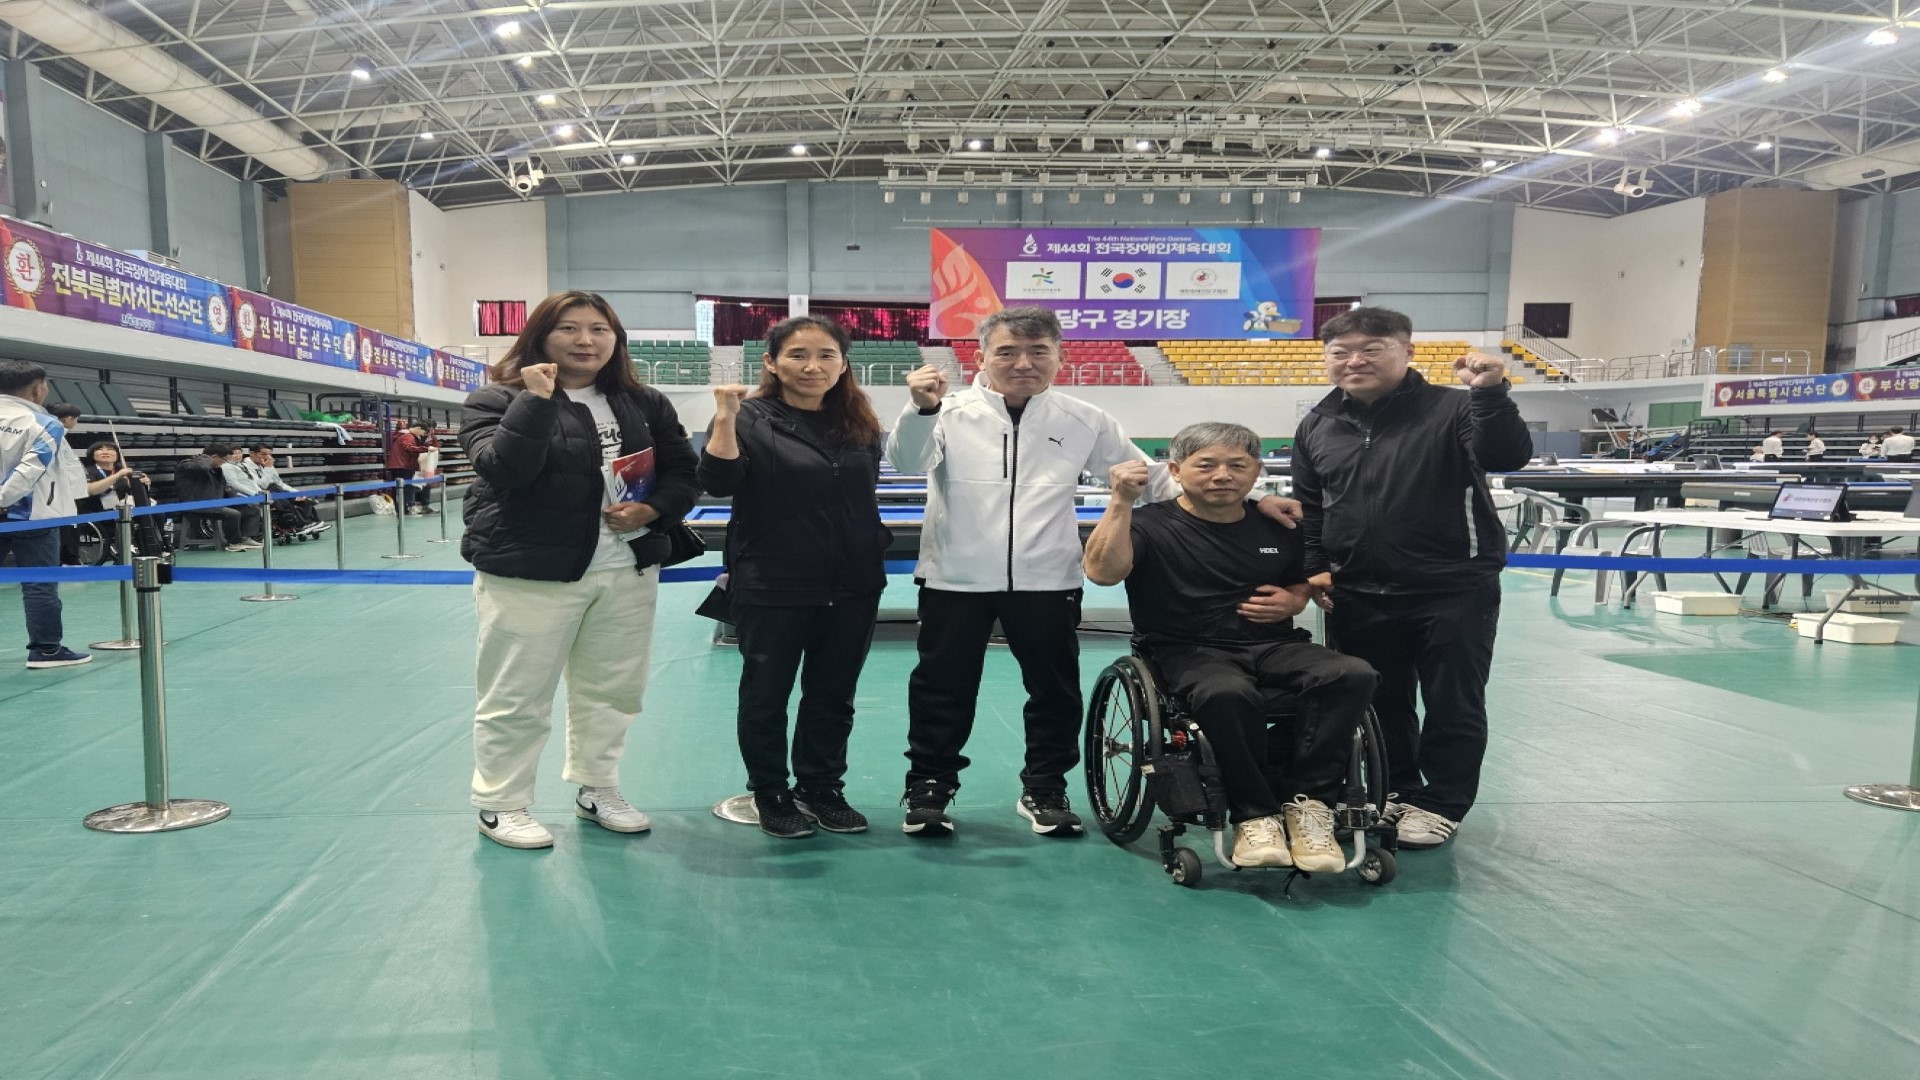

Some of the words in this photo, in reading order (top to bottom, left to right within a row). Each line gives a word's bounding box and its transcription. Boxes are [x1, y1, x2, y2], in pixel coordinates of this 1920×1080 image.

[1047, 243, 1090, 254] 제44회
[1095, 243, 1231, 255] 전국장애인체육대회
[16, 253, 35, 282] 환
[85, 250, 113, 271] 제44회
[115, 258, 187, 292] 전국장애인체육대회
[51, 262, 204, 325] 전북특별자치도선수단
[213, 303, 223, 326] 영
[1055, 309, 1107, 329] 당구
[1113, 309, 1190, 329] 경기장
[260, 315, 342, 355] 전라남도선수단
[1735, 384, 1826, 400] 서울특별시선수단
[1880, 378, 1920, 392] 부산광
